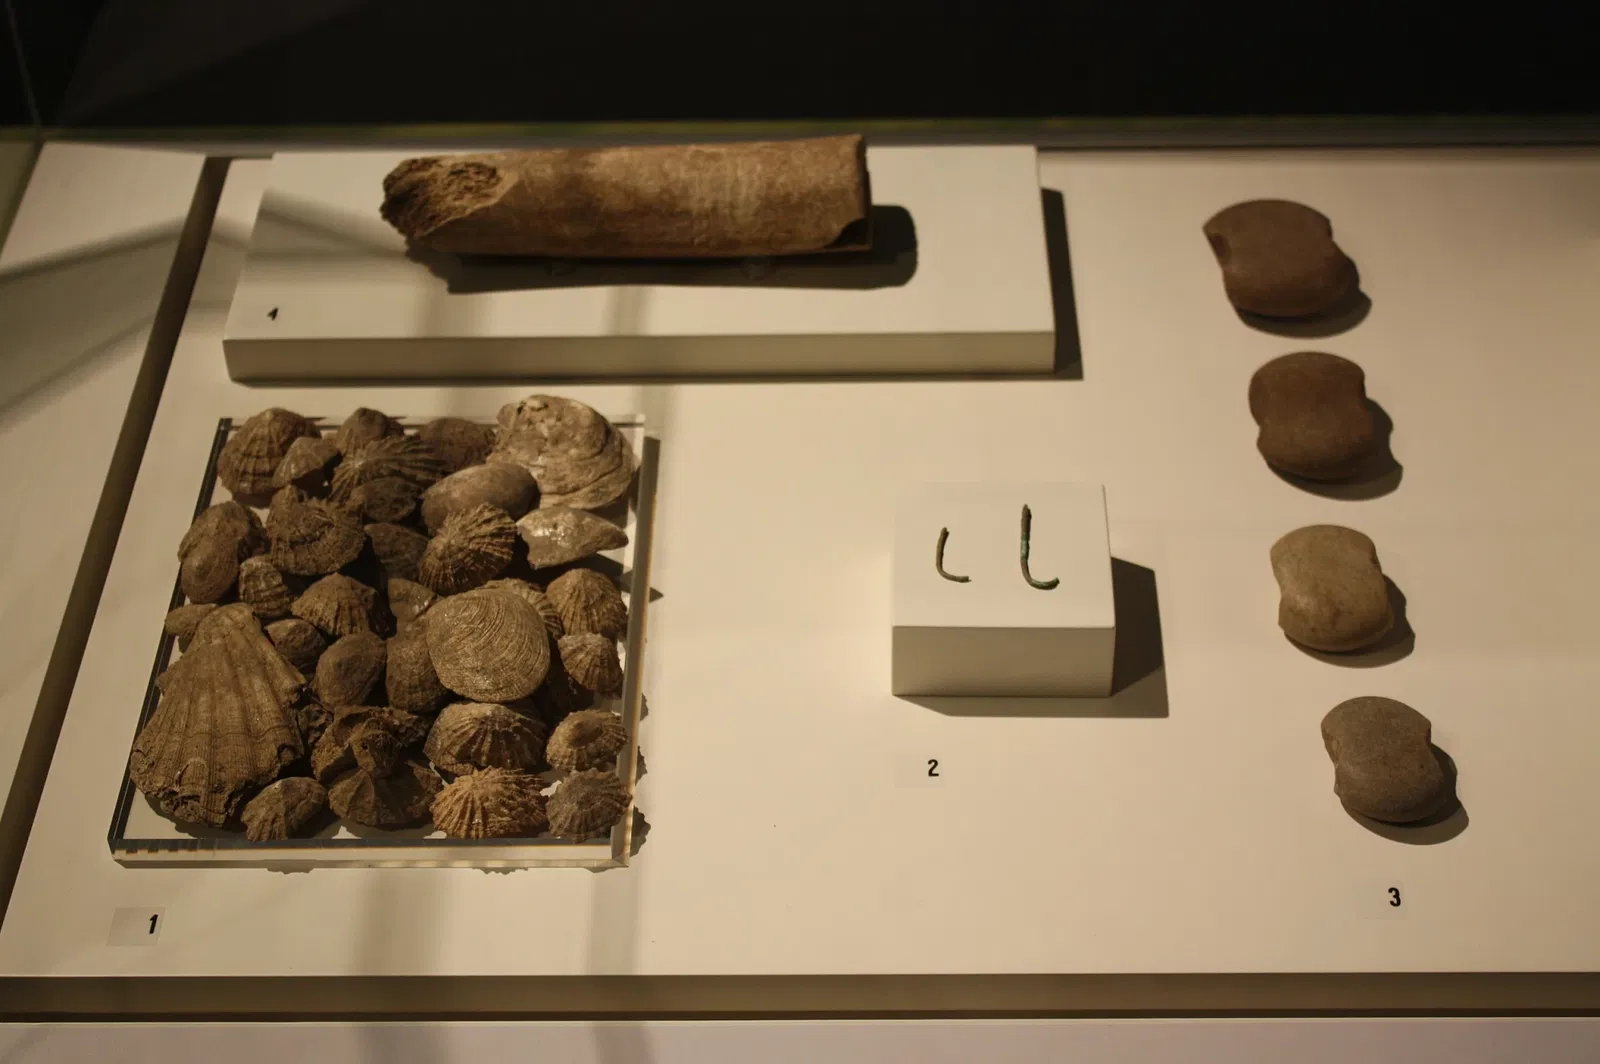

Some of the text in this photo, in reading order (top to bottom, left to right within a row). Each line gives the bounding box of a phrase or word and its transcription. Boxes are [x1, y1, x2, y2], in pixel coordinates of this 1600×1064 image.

[927, 758, 940, 777] 2
[1387, 886, 1402, 908] 3
[148, 913, 159, 935] 1
